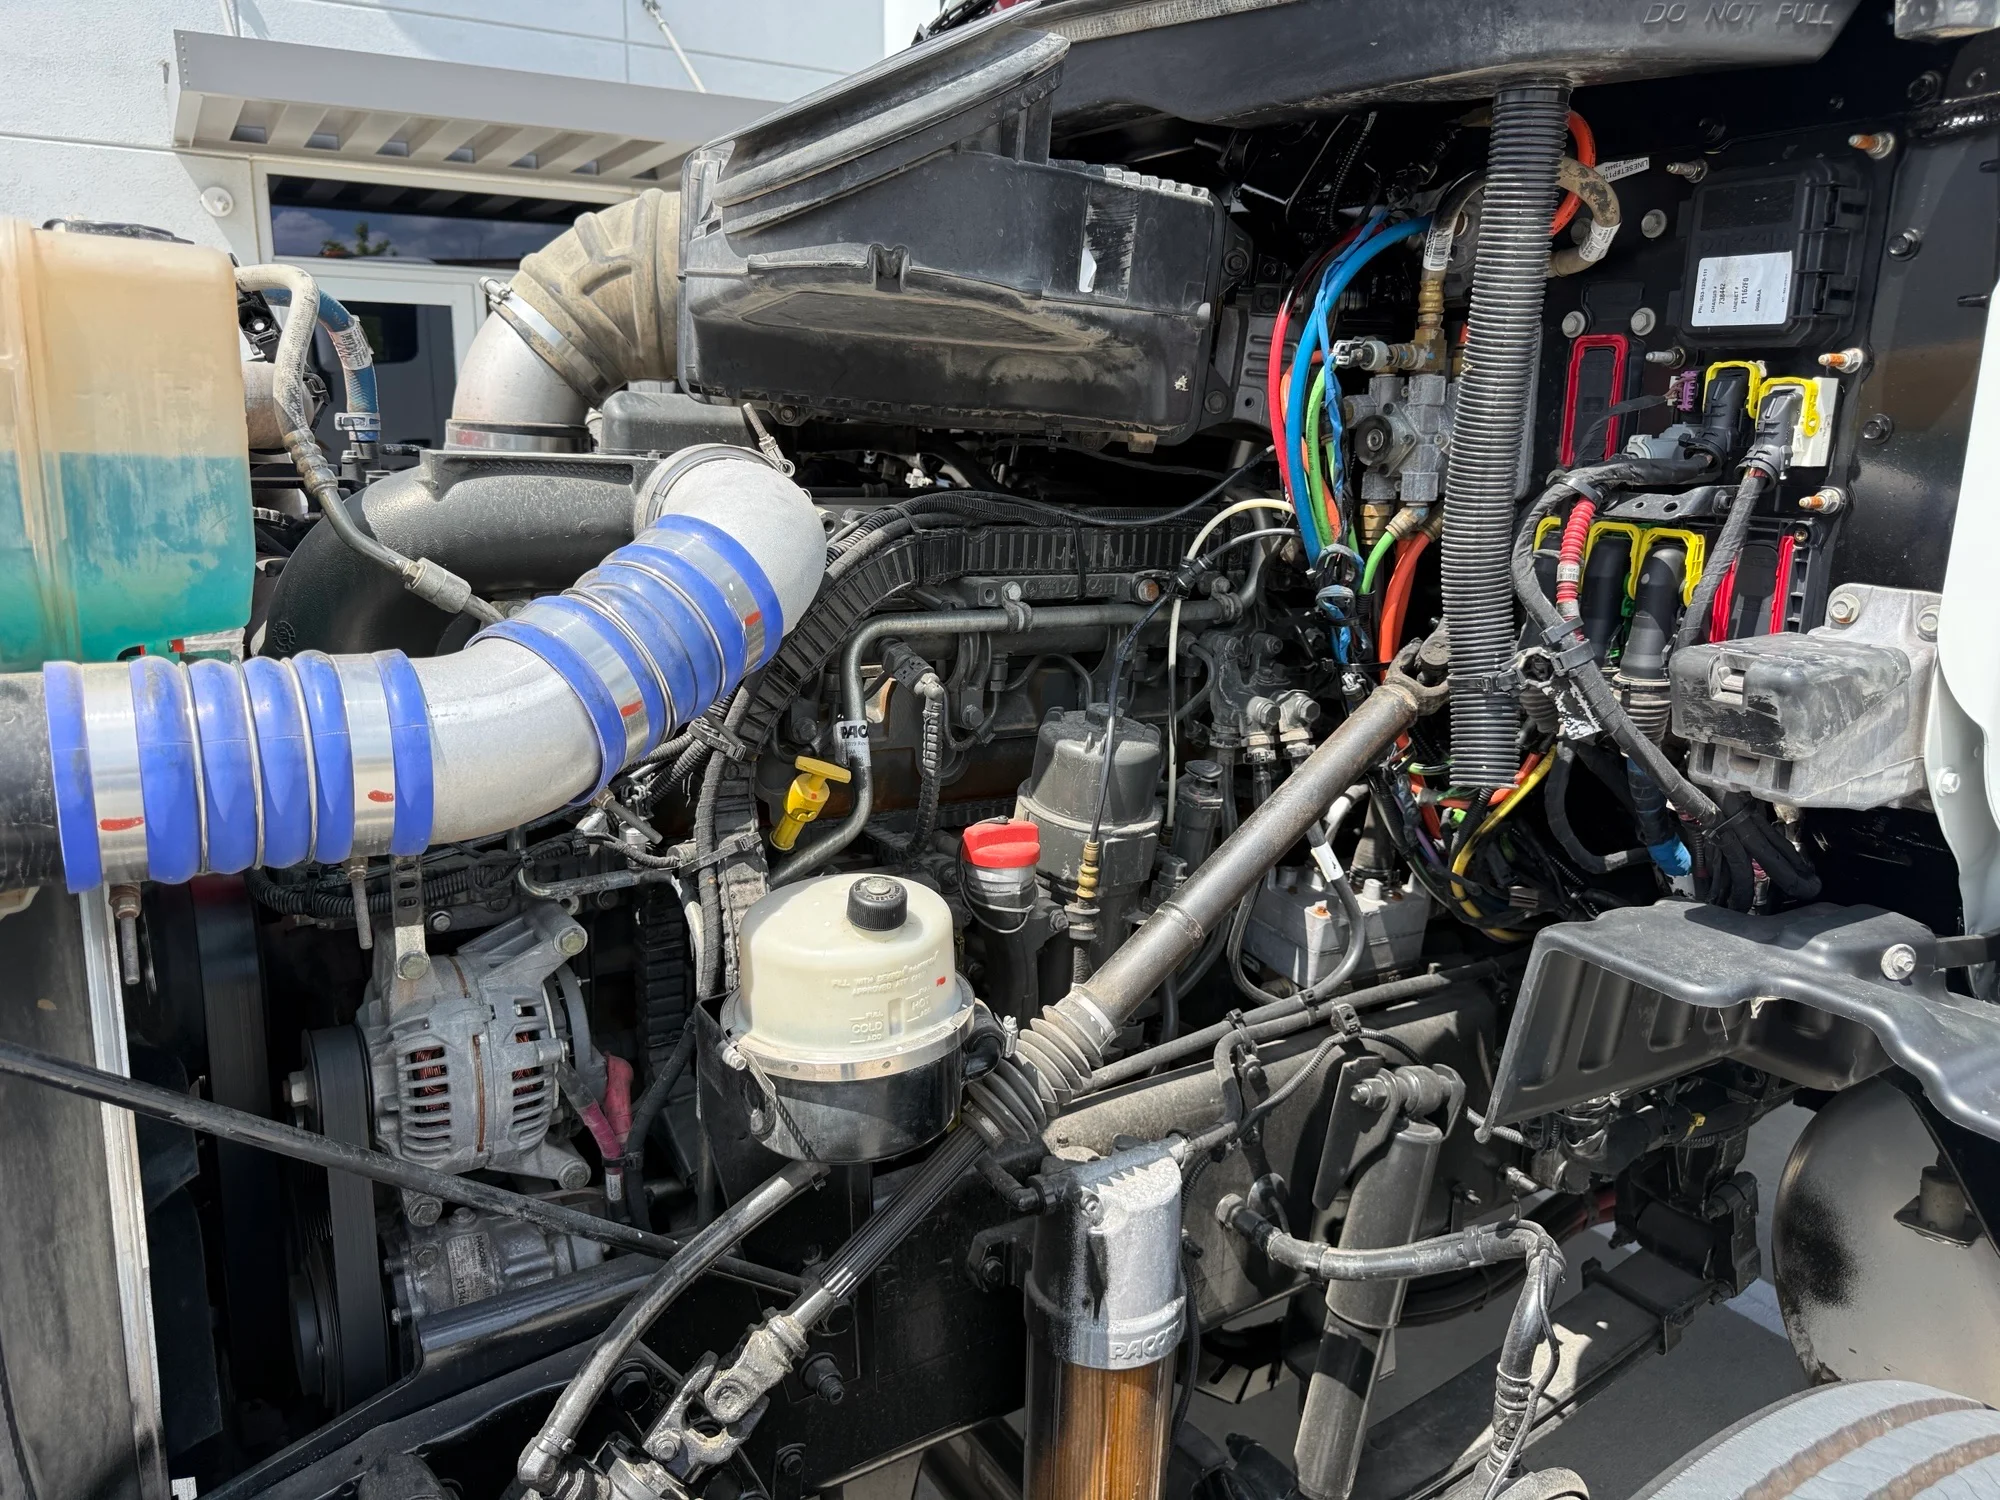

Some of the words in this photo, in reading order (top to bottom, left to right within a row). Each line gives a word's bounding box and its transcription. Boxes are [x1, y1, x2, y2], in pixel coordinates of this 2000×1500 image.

[1644, 3, 1687, 24] DO
[1704, 3, 1762, 24] NOT
[1775, 3, 1834, 25] PULL
[1710, 290, 1718, 314] CHASSIS
[1718, 283, 1727, 305] 738442
[911, 995, 930, 1011] HOT
[851, 1020, 883, 1034] COLD
[1109, 1319, 1181, 1360] PACC
